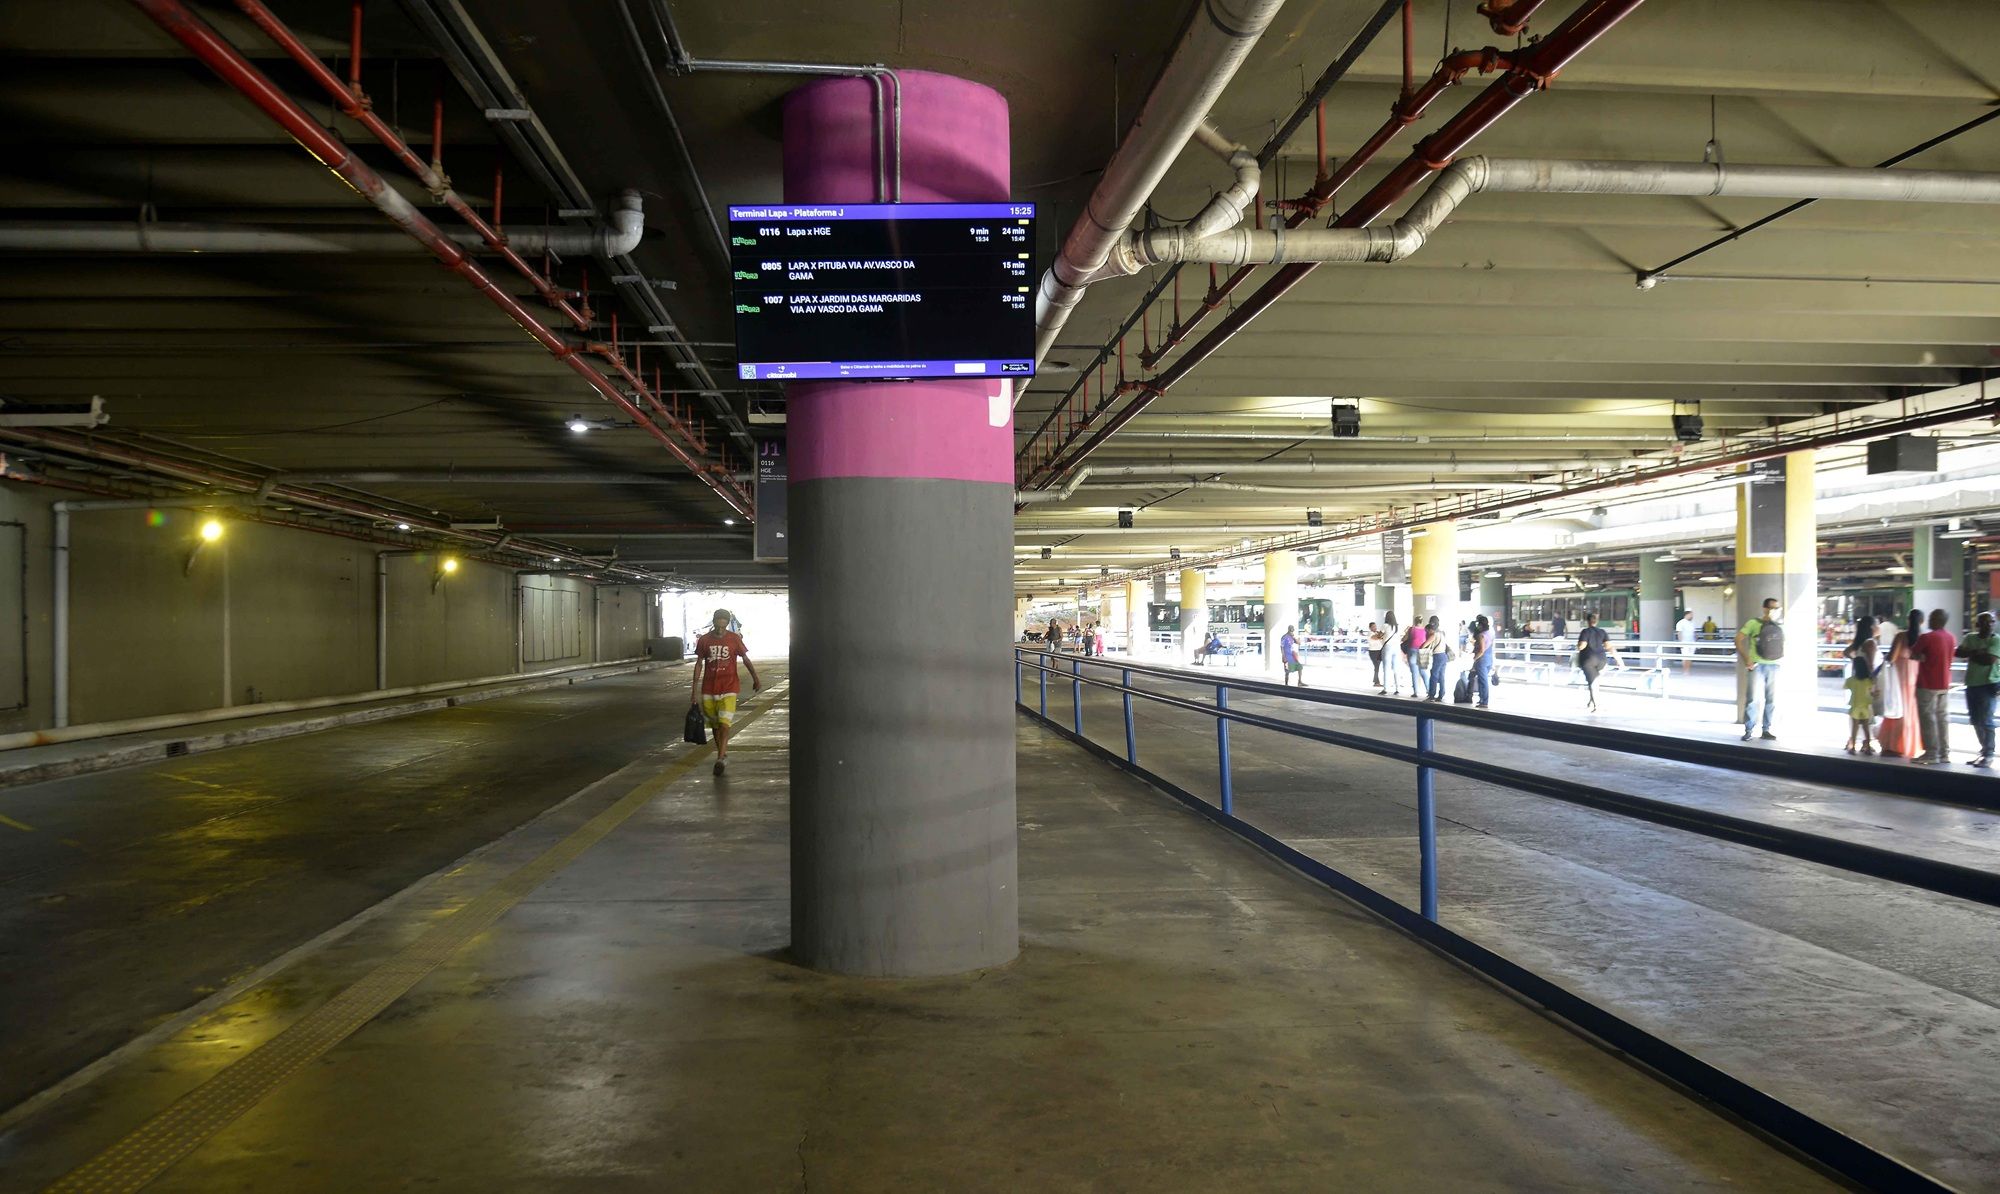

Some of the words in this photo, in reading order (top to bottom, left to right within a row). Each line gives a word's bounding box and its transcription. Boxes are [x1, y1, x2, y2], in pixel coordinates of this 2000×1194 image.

[733, 209, 766, 218] Terminal
[768, 209, 787, 218] Lapa
[794, 209, 837, 217] Plataforma
[838, 208, 844, 216] J
[760, 228, 780, 236] 0116
[787, 228, 805, 237] Lapa
[761, 262, 782, 270] 0805
[788, 262, 809, 270] LAPA
[789, 272, 814, 280] GAMA
[790, 296, 811, 304] LAPA
[869, 294, 921, 303] MARGARIDAS
[761, 441, 780, 456] J1
